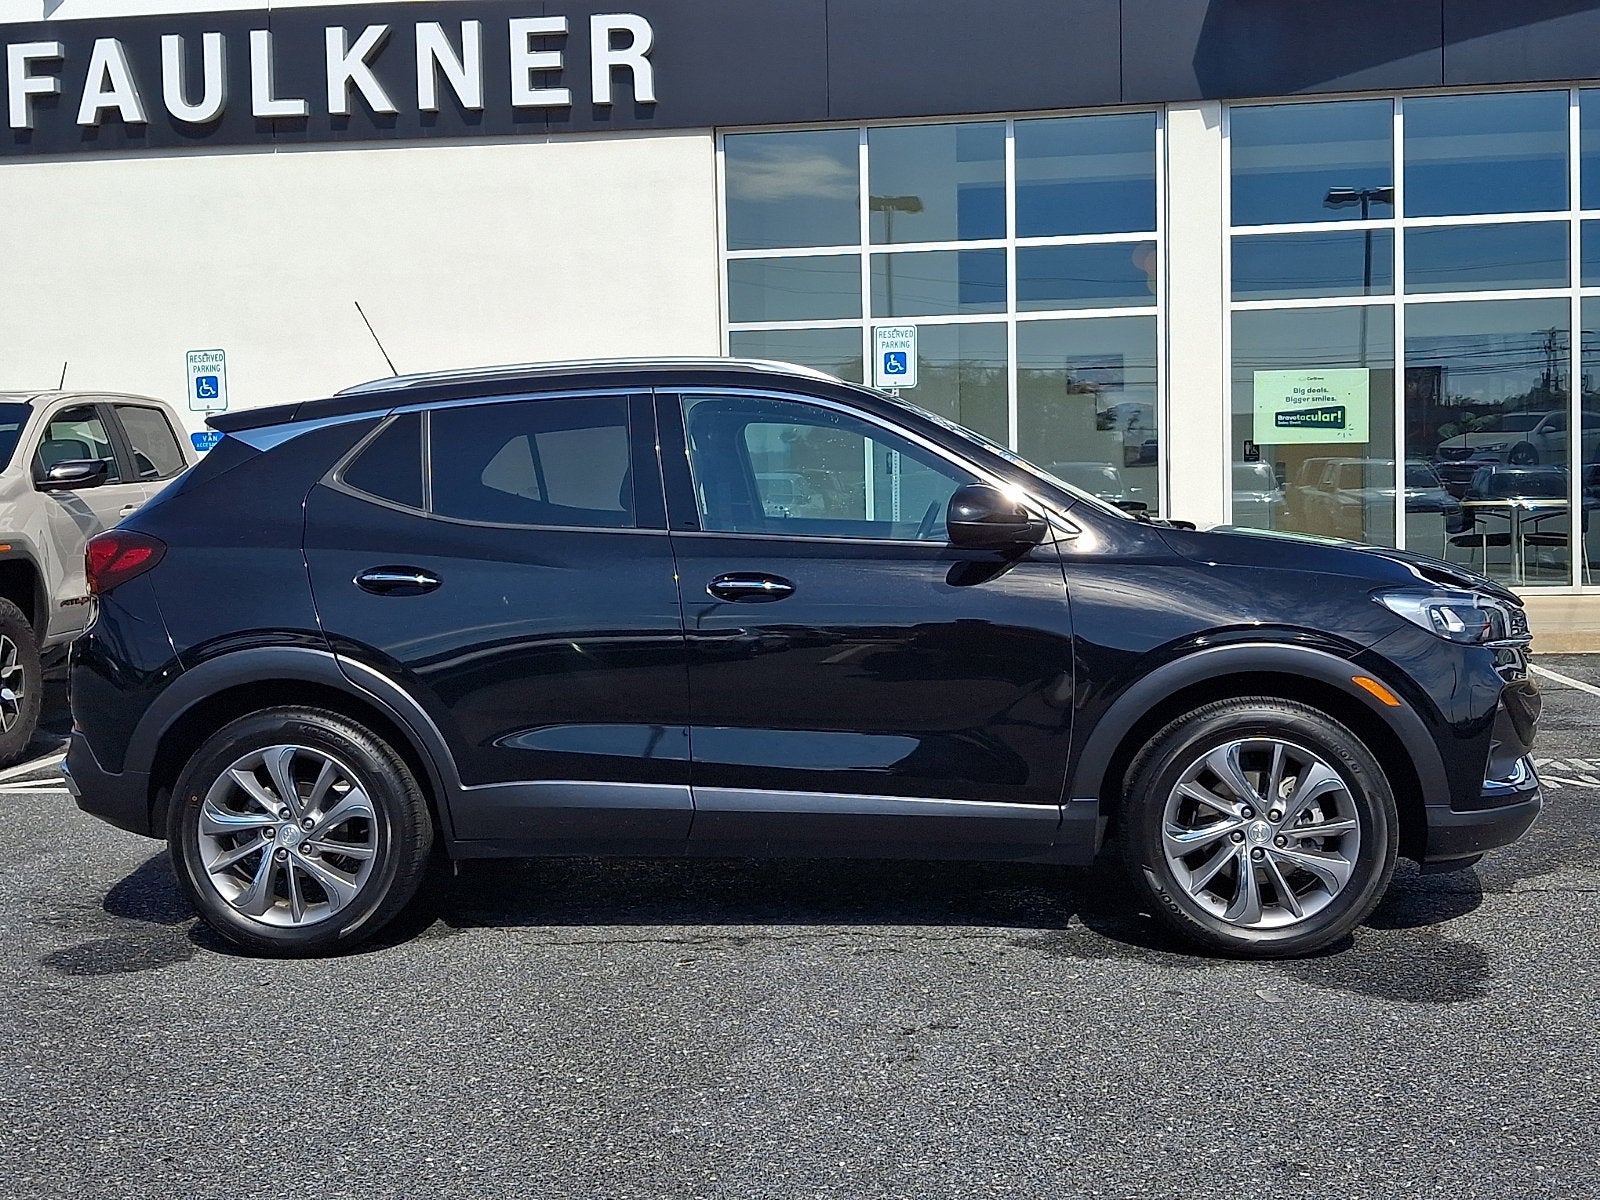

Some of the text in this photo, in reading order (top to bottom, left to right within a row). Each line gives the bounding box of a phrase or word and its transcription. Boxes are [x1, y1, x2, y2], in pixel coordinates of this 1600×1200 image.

[7, 14, 656, 129] FAULKNER
[879, 330, 914, 338] RESERVED
[882, 341, 910, 349] PARKING
[190, 354, 224, 363] RESERVED
[193, 364, 221, 373] PARKING
[1293, 387, 1306, 395] Big
[1285, 396, 1310, 404] Bigger
